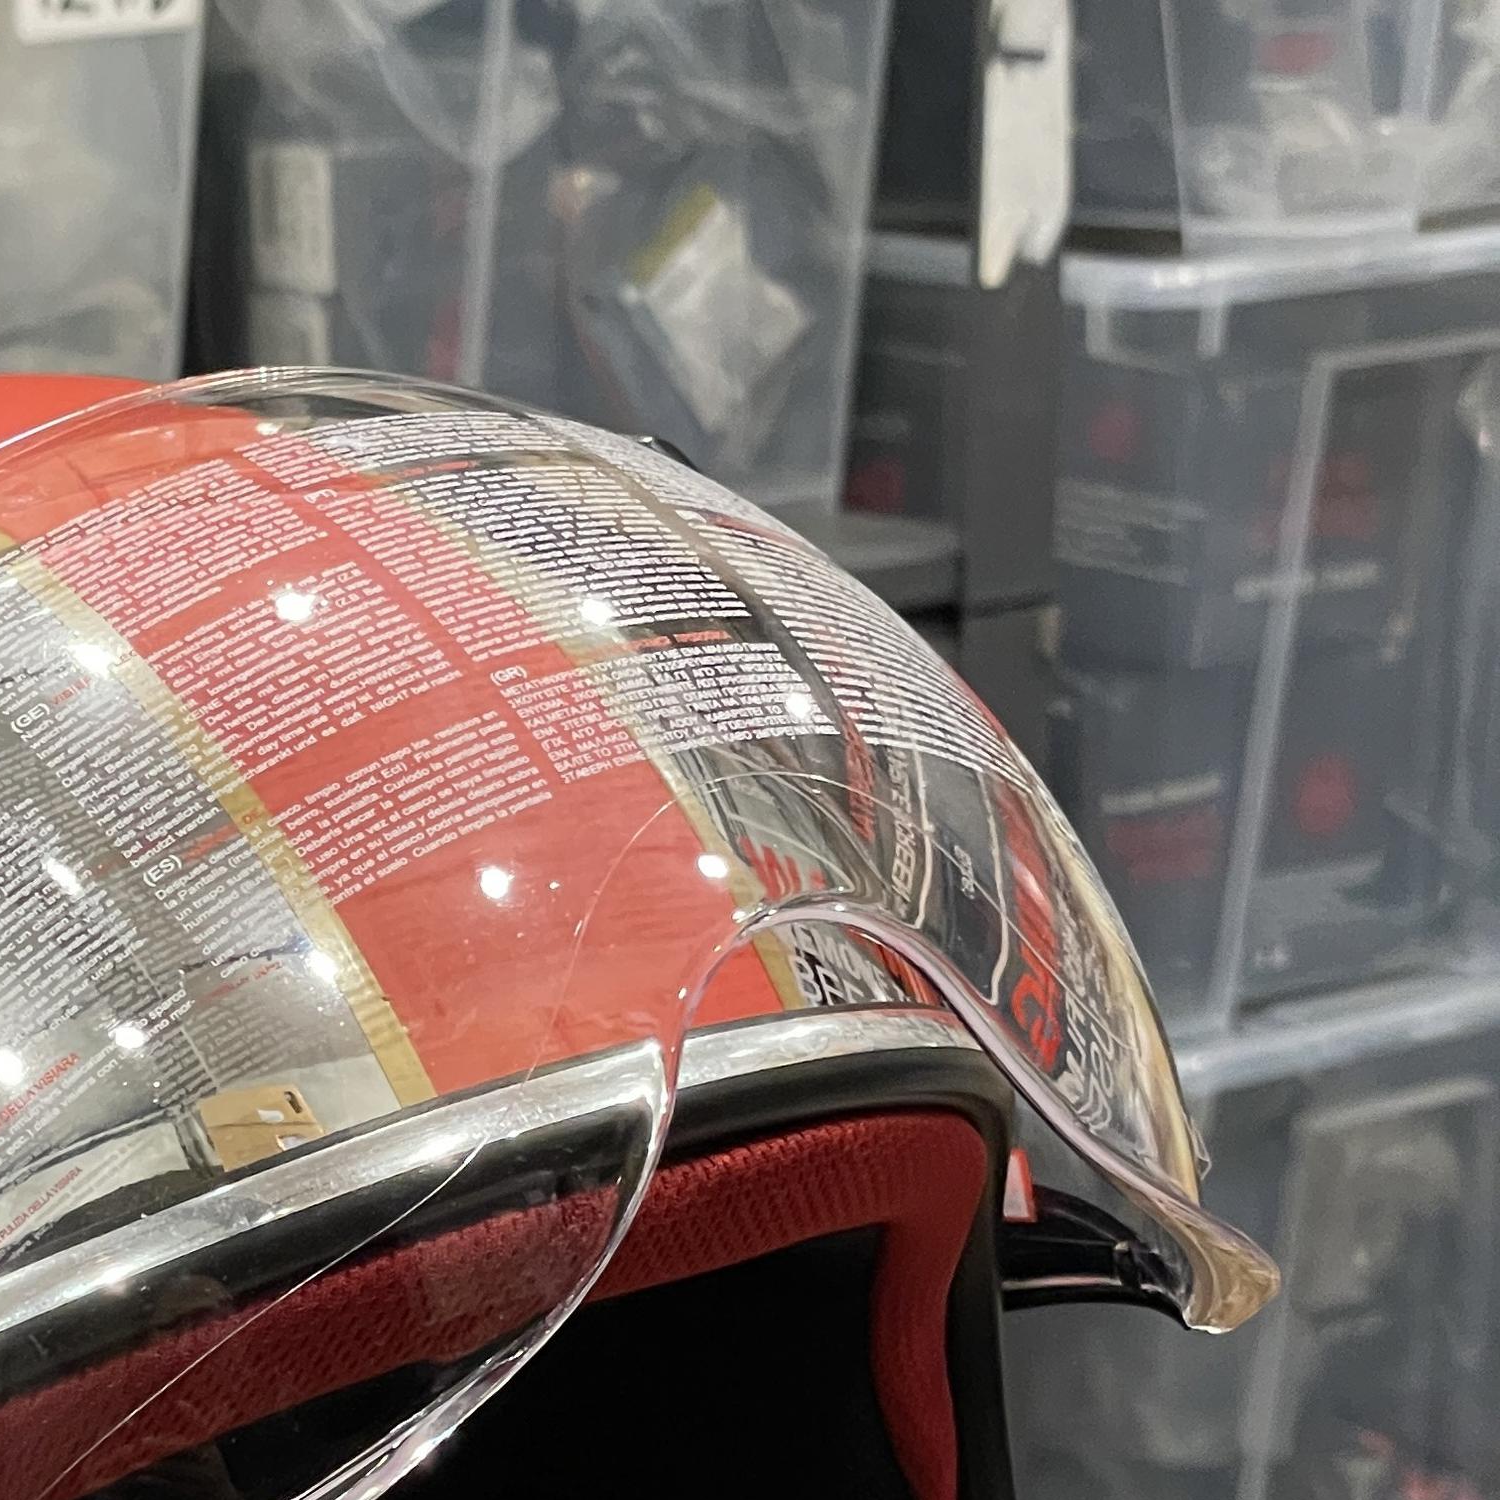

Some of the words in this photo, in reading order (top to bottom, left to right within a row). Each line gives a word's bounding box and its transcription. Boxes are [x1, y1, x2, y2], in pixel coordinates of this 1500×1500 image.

[488, 665, 527, 684] (GR)
[8, 700, 52, 735] (GE)
[140, 852, 184, 887] (ES)
